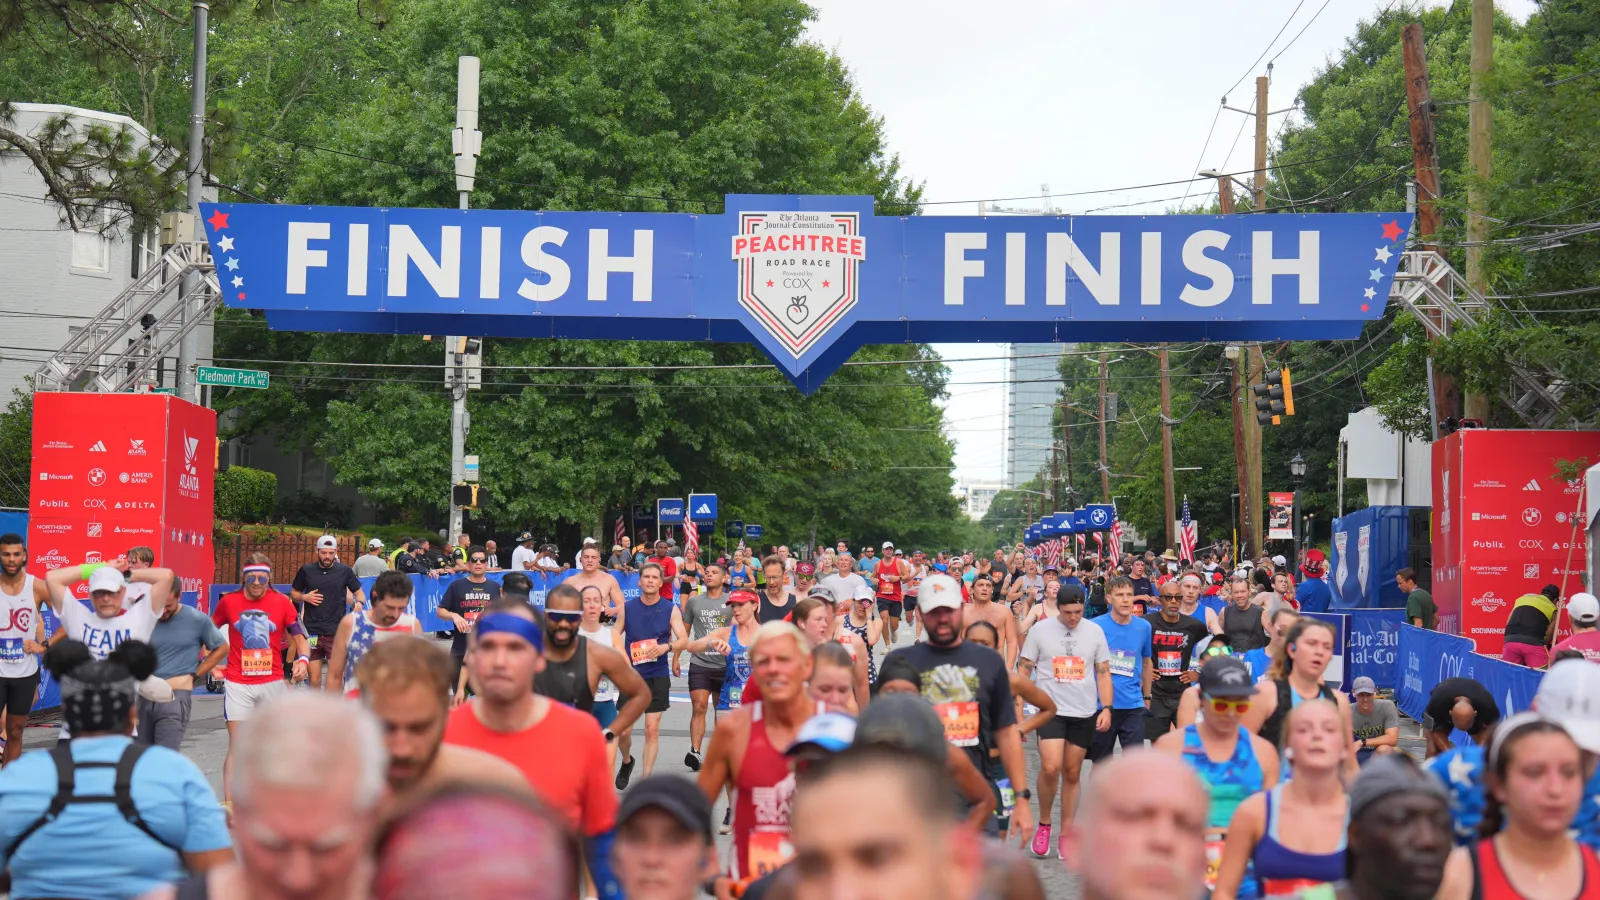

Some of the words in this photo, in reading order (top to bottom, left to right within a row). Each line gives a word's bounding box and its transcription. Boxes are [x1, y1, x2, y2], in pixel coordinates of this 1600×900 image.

[779, 213, 793, 222] The
[794, 213, 820, 222] Atlanta
[764, 221, 835, 230] Journal-Constitution
[735, 234, 863, 256] PEACHTREE
[286, 221, 654, 302] FINISH
[766, 258, 796, 267] ROAD
[802, 258, 831, 267] RACE
[806, 270, 814, 278] by
[944, 229, 1320, 307] FINISH
[783, 277, 813, 292] COX
[199, 369, 236, 384] Piedmont
[238, 373, 256, 385] Park
[179, 473, 199, 492] ATLANTA
[83, 499, 107, 510] COX
[1481, 513, 1507, 521] Microsoft
[1518, 539, 1545, 551] COX
[465, 593, 491, 601] BRAVES
[624, 588, 640, 597] SIDE
[701, 609, 721, 617] Right
[83, 622, 132, 649] TEAM
[1153, 634, 1183, 646] run
[1350, 631, 1373, 649] The
